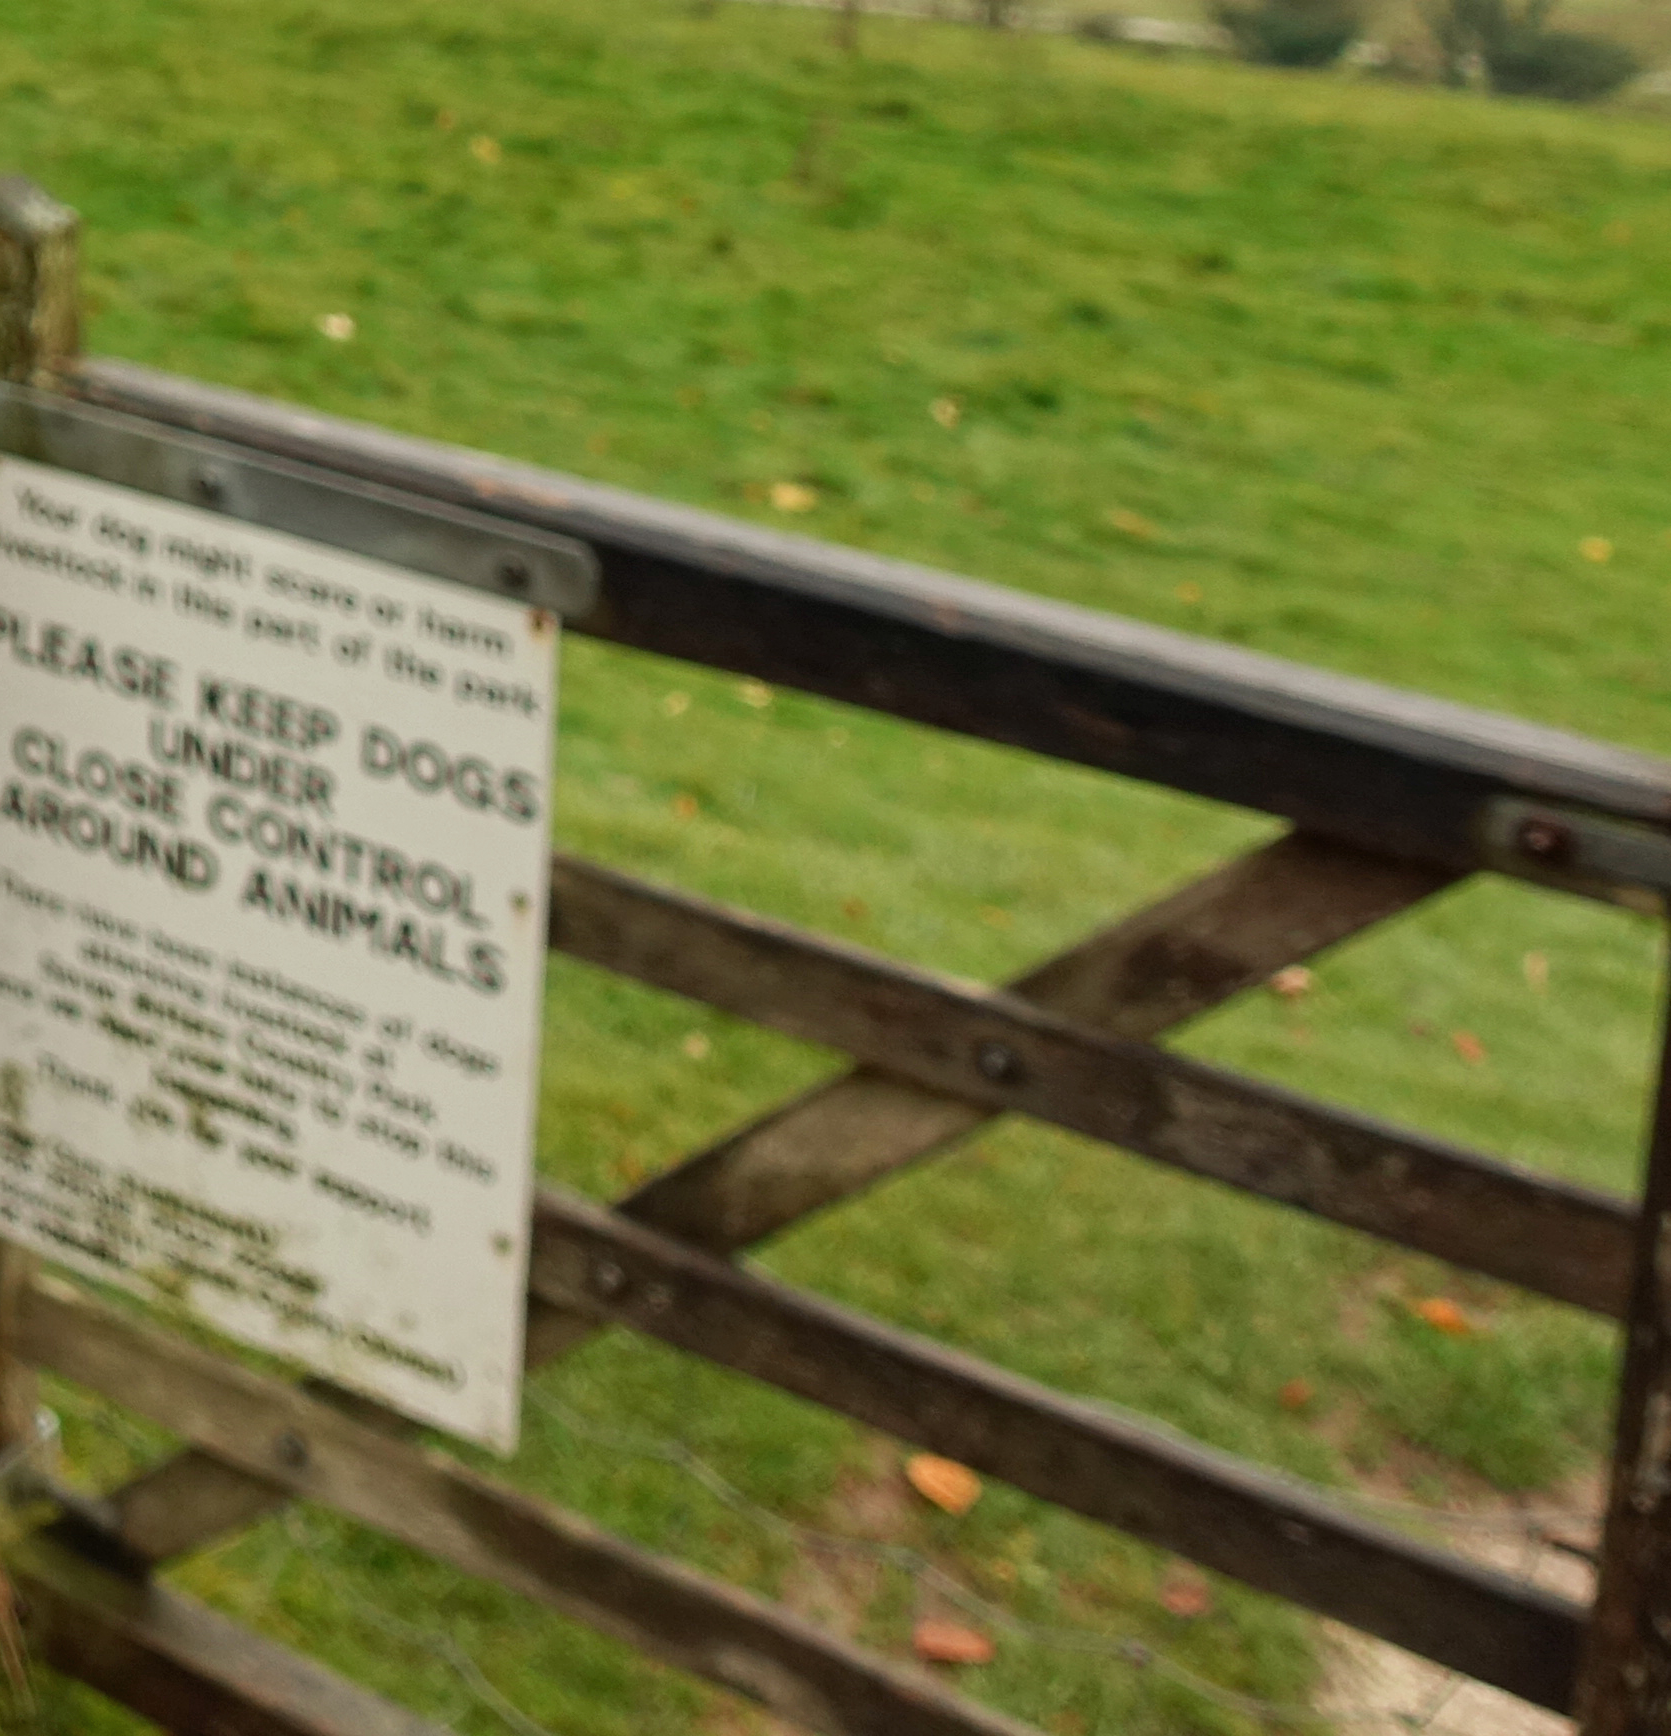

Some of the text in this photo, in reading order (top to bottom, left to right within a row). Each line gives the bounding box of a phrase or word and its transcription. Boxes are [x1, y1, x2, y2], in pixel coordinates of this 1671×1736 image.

[12, 727, 483, 927] CLOSE CONTROL
[149, 723, 332, 810] UNDER
[198, 678, 339, 748] KEEP
[360, 726, 538, 823] DOGS
[0, 784, 216, 890] AROUND
[243, 868, 502, 992] ANIMALS
